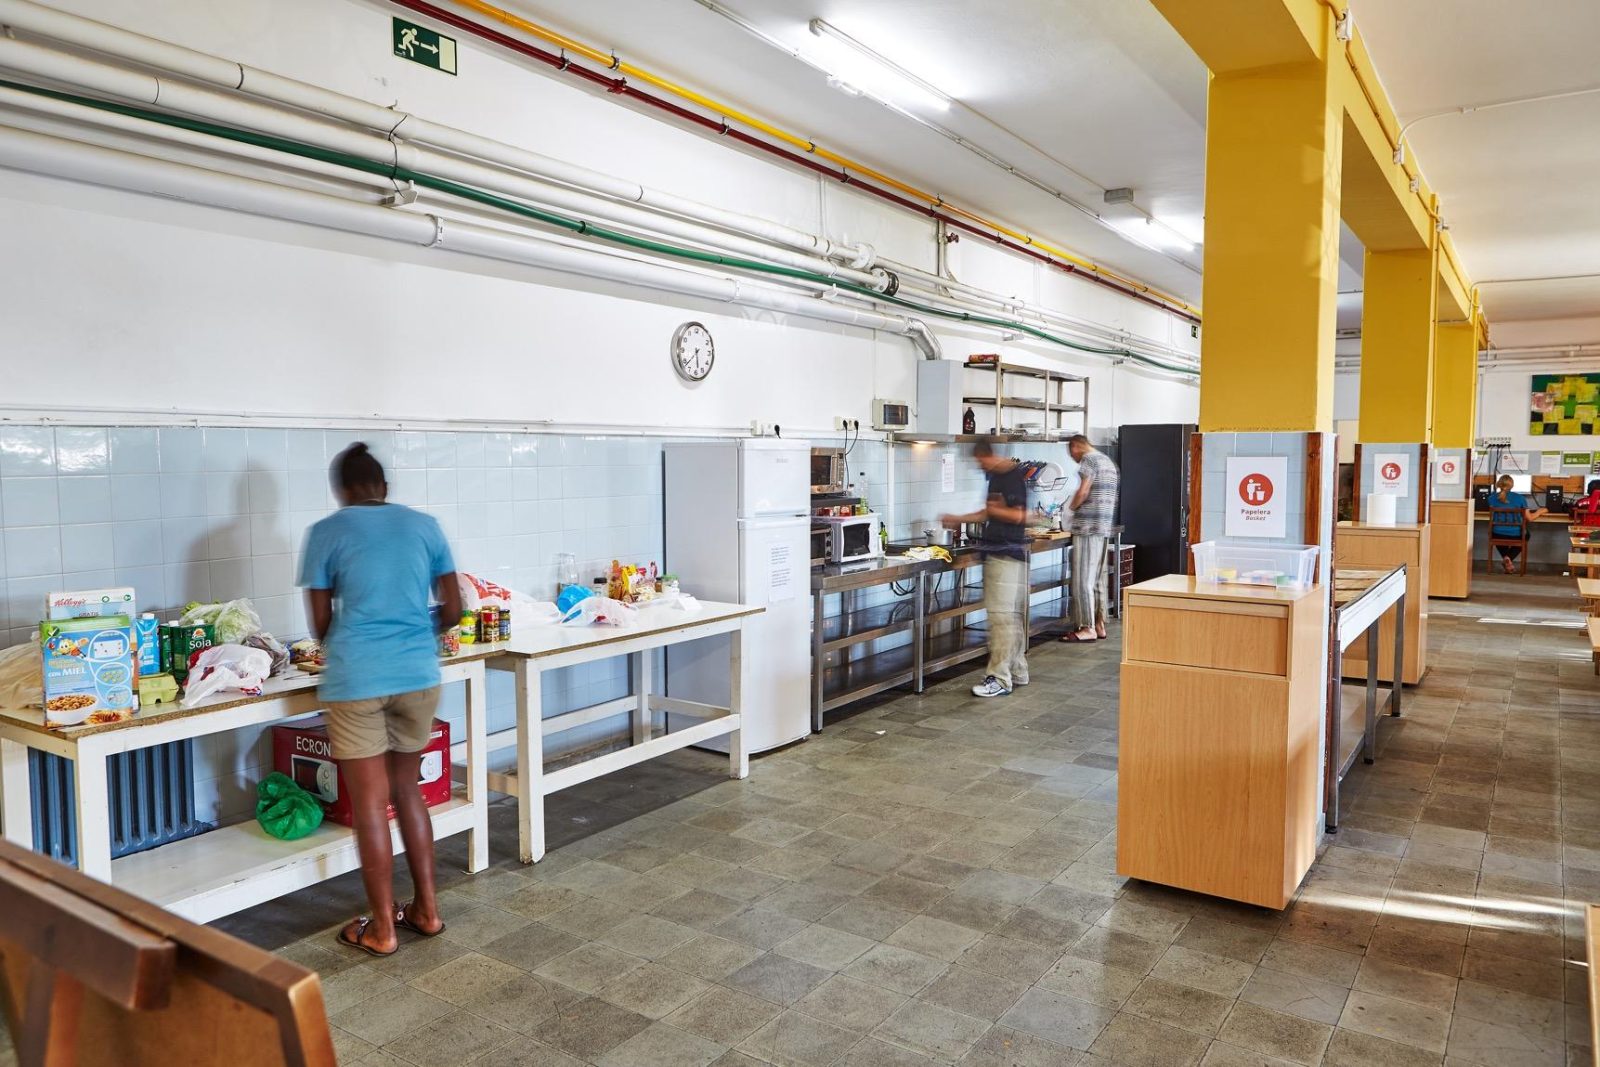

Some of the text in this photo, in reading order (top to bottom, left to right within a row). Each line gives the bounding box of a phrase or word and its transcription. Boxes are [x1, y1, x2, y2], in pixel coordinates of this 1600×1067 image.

[189, 639, 212, 650] Soja
[62, 667, 87, 677] MIEL
[296, 735, 331, 757] ECRON
